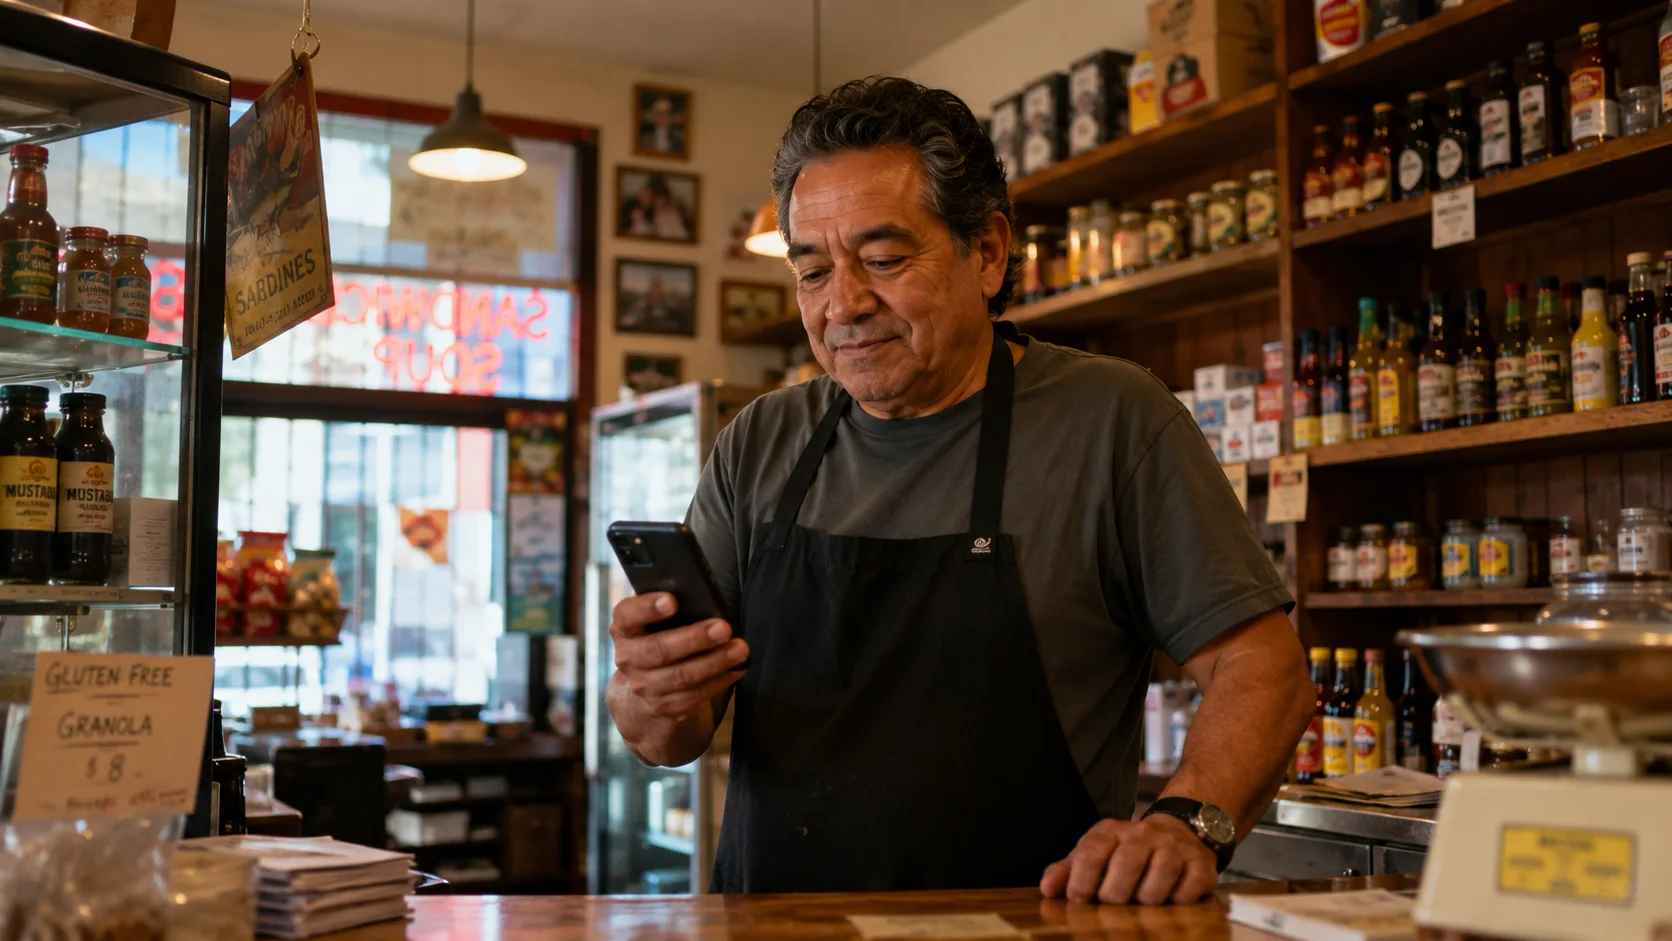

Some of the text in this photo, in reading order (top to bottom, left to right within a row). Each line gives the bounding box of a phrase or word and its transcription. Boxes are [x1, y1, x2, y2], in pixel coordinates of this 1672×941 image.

[45, 660, 174, 688] GLUTEN FREE
[57, 709, 153, 740] GRANOLA
